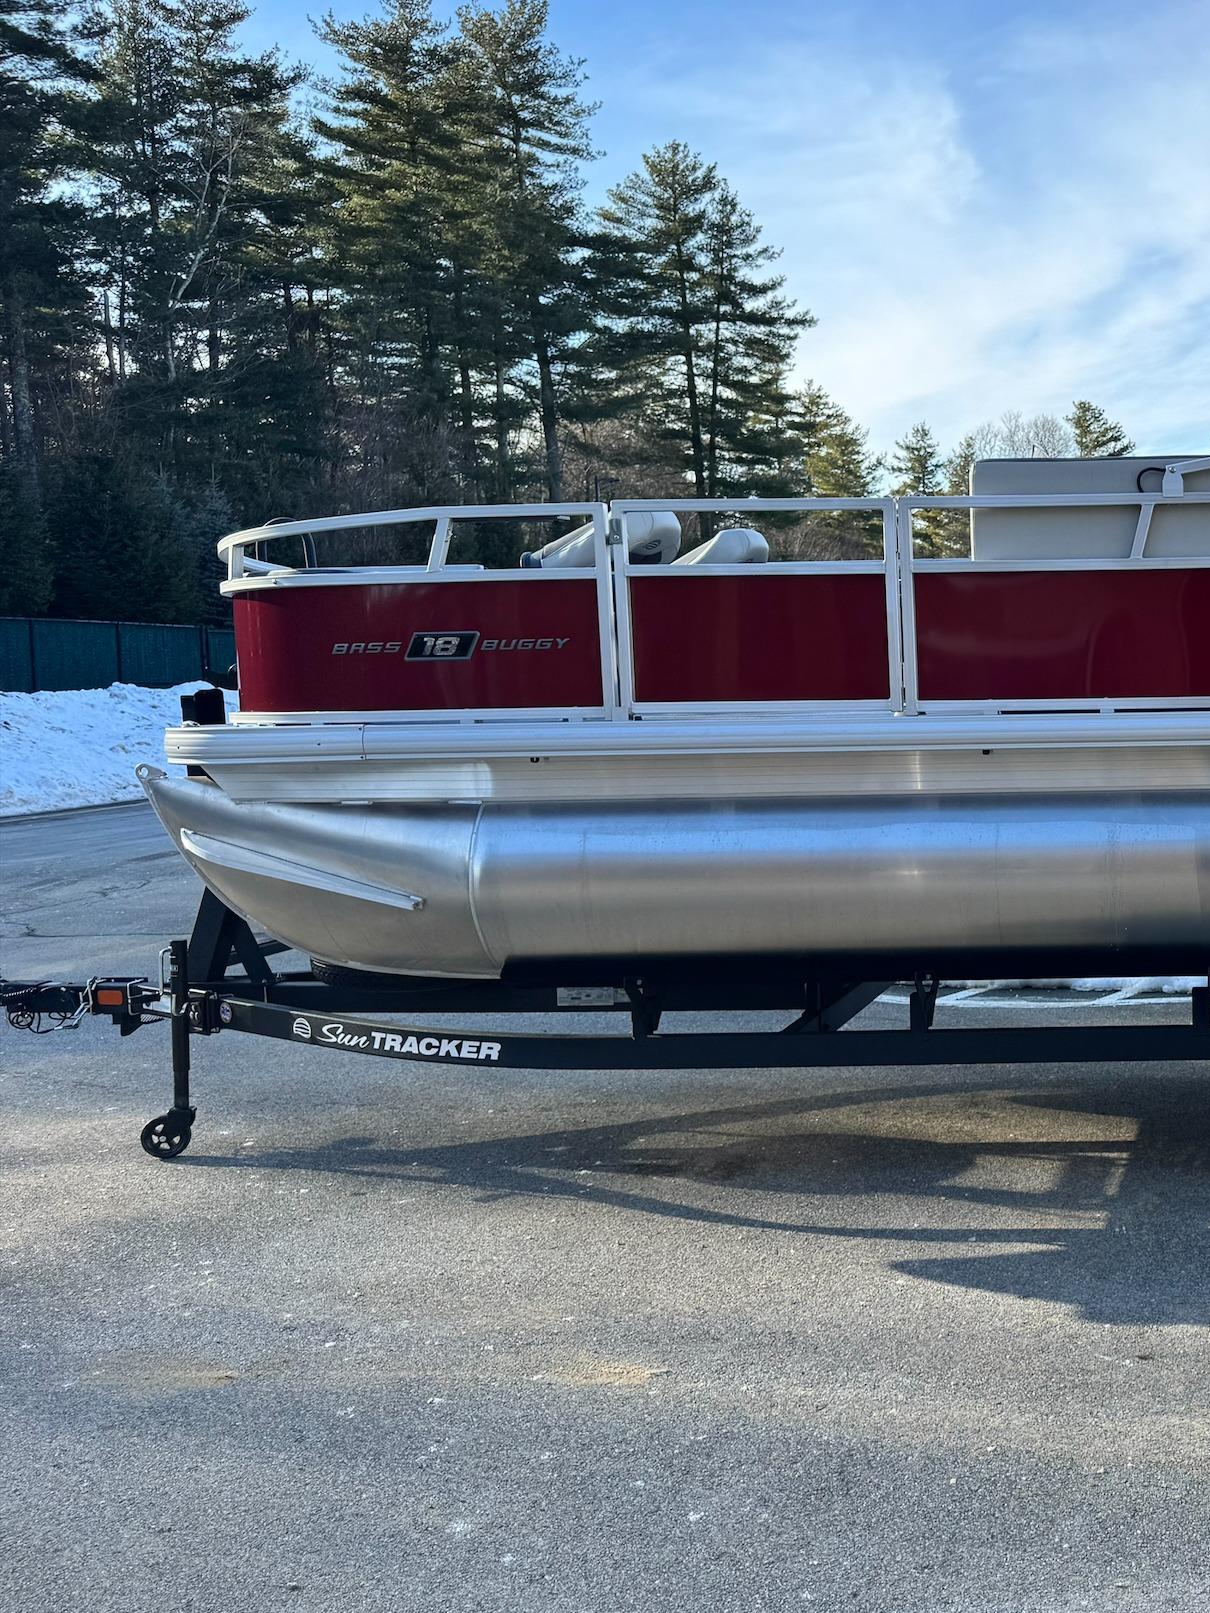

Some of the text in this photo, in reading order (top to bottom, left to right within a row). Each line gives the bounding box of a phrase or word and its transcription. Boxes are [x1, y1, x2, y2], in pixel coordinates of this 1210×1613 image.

[331, 636, 570, 656] BASS 18 BUGGY
[316, 1023, 502, 1060] Sun TRACKER
